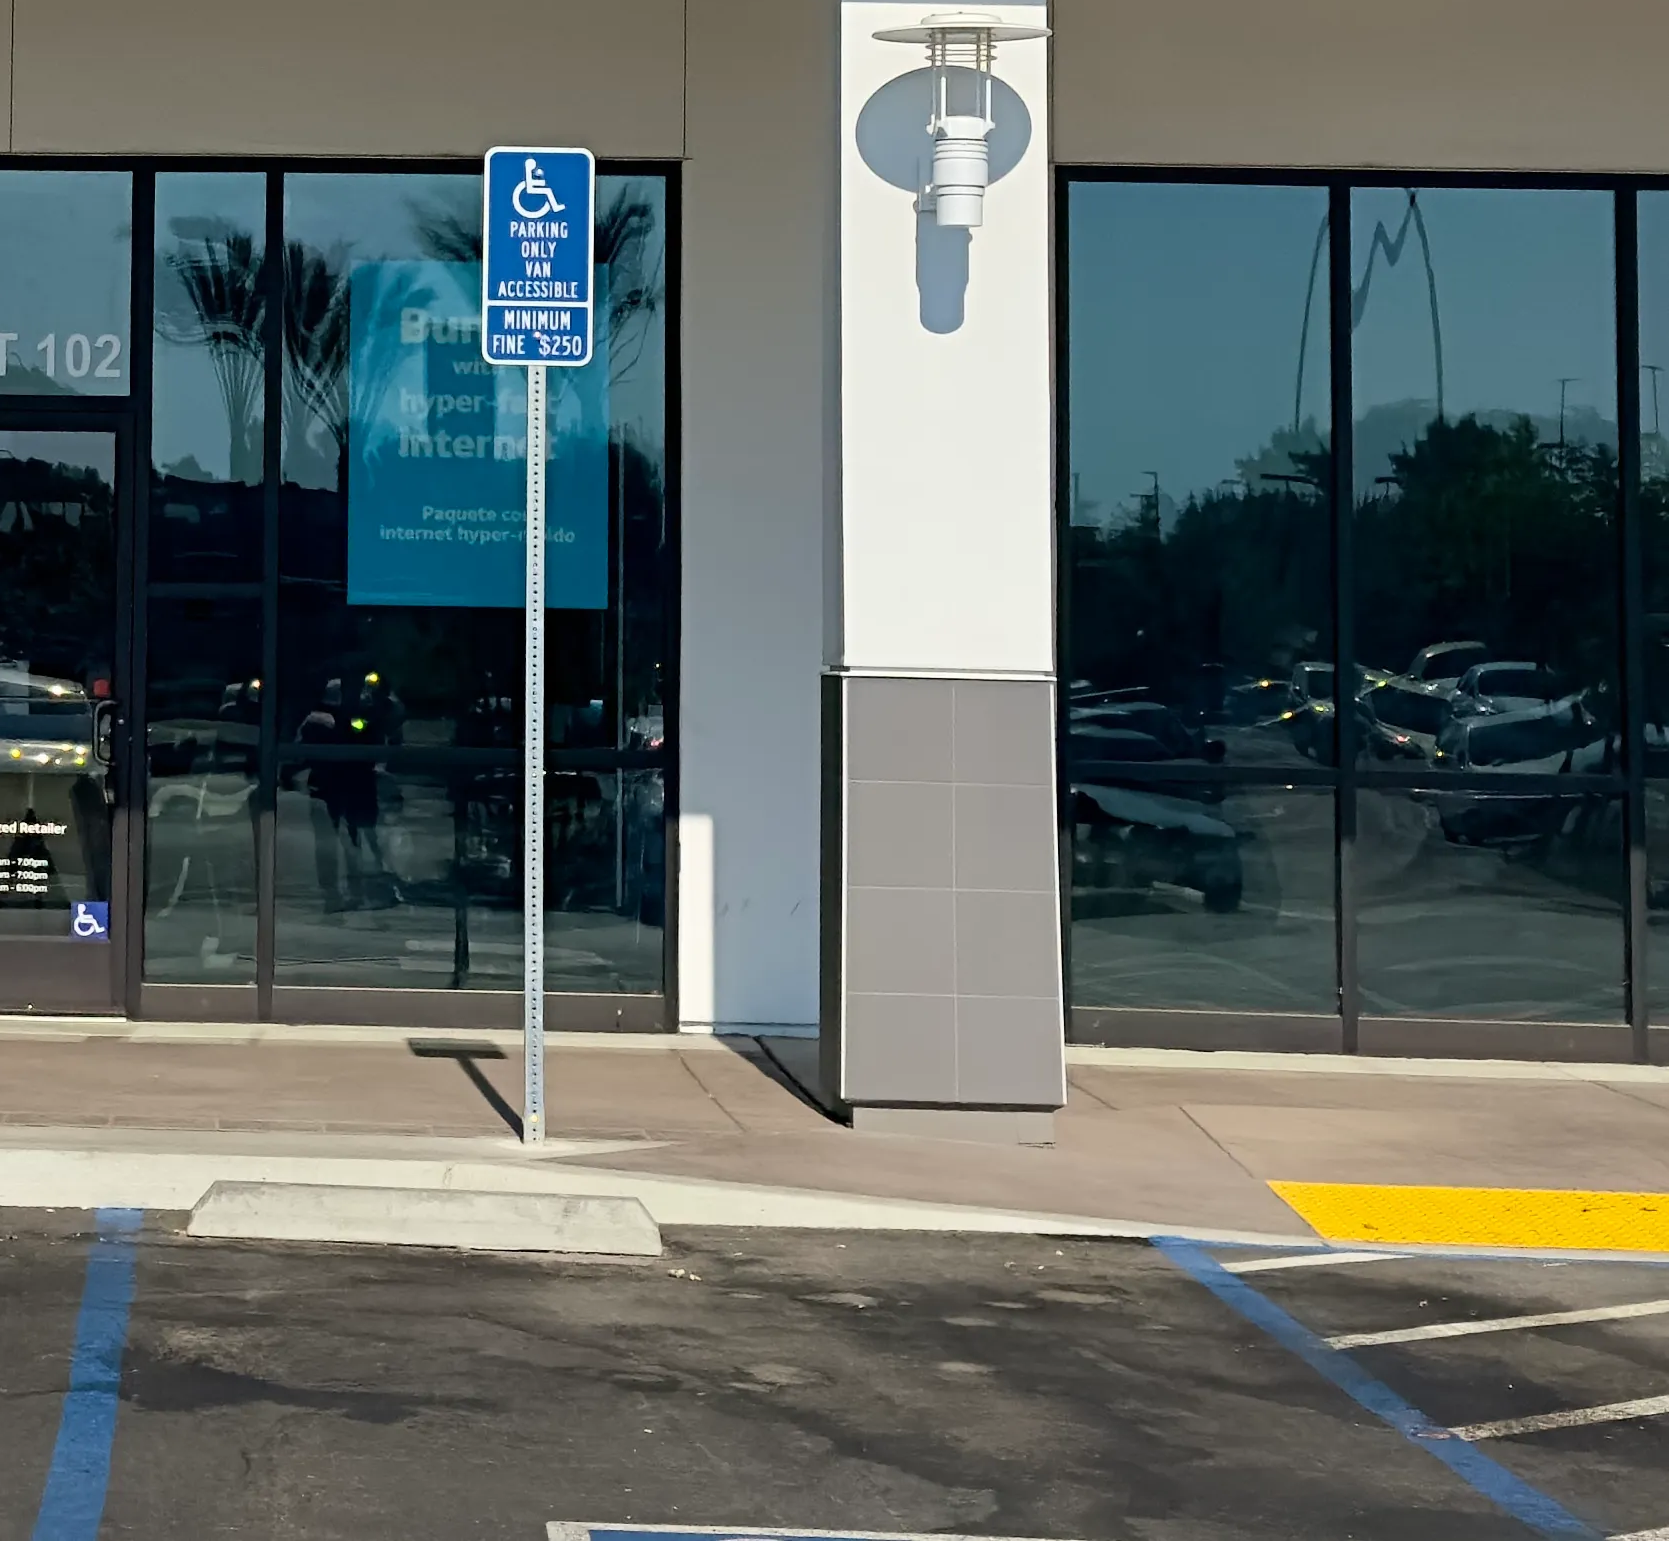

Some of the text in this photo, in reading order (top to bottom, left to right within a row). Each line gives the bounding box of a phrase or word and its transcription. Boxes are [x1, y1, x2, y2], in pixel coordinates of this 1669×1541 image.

[510, 221, 569, 239] PARKING
[521, 240, 557, 258] ONLY
[525, 260, 552, 278] VAN
[498, 280, 579, 299] ACCESSIBLE
[504, 309, 571, 331] MINIMUM
[492, 334, 583, 357] FINE $250
[36, 333, 122, 379] 102
[421, 504, 497, 525] Paquete
[379, 525, 453, 541] internet
[19, 822, 67, 835] Retailer
